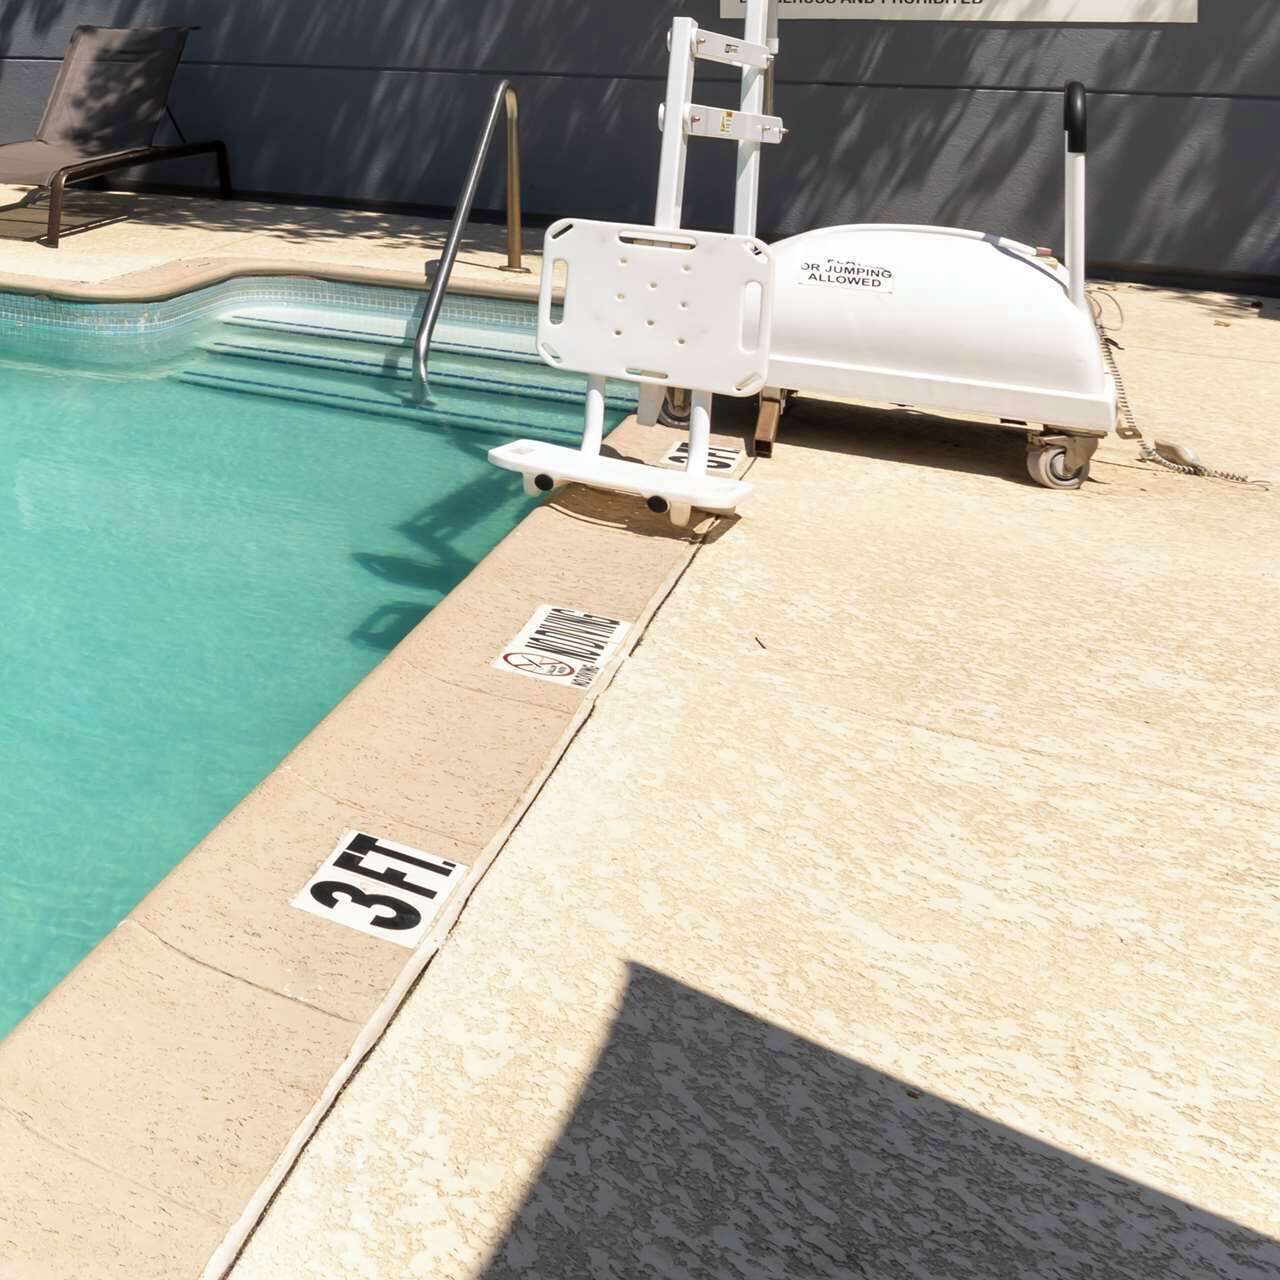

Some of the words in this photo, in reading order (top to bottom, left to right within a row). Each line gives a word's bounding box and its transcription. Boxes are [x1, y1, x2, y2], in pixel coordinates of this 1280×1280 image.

[808, 273, 882, 287] ALLOWED
[825, 265, 893, 279] JUMPING
[535, 609, 620, 650] DIVING
[525, 637, 600, 663] NO
[310, 880, 422, 931] 3
